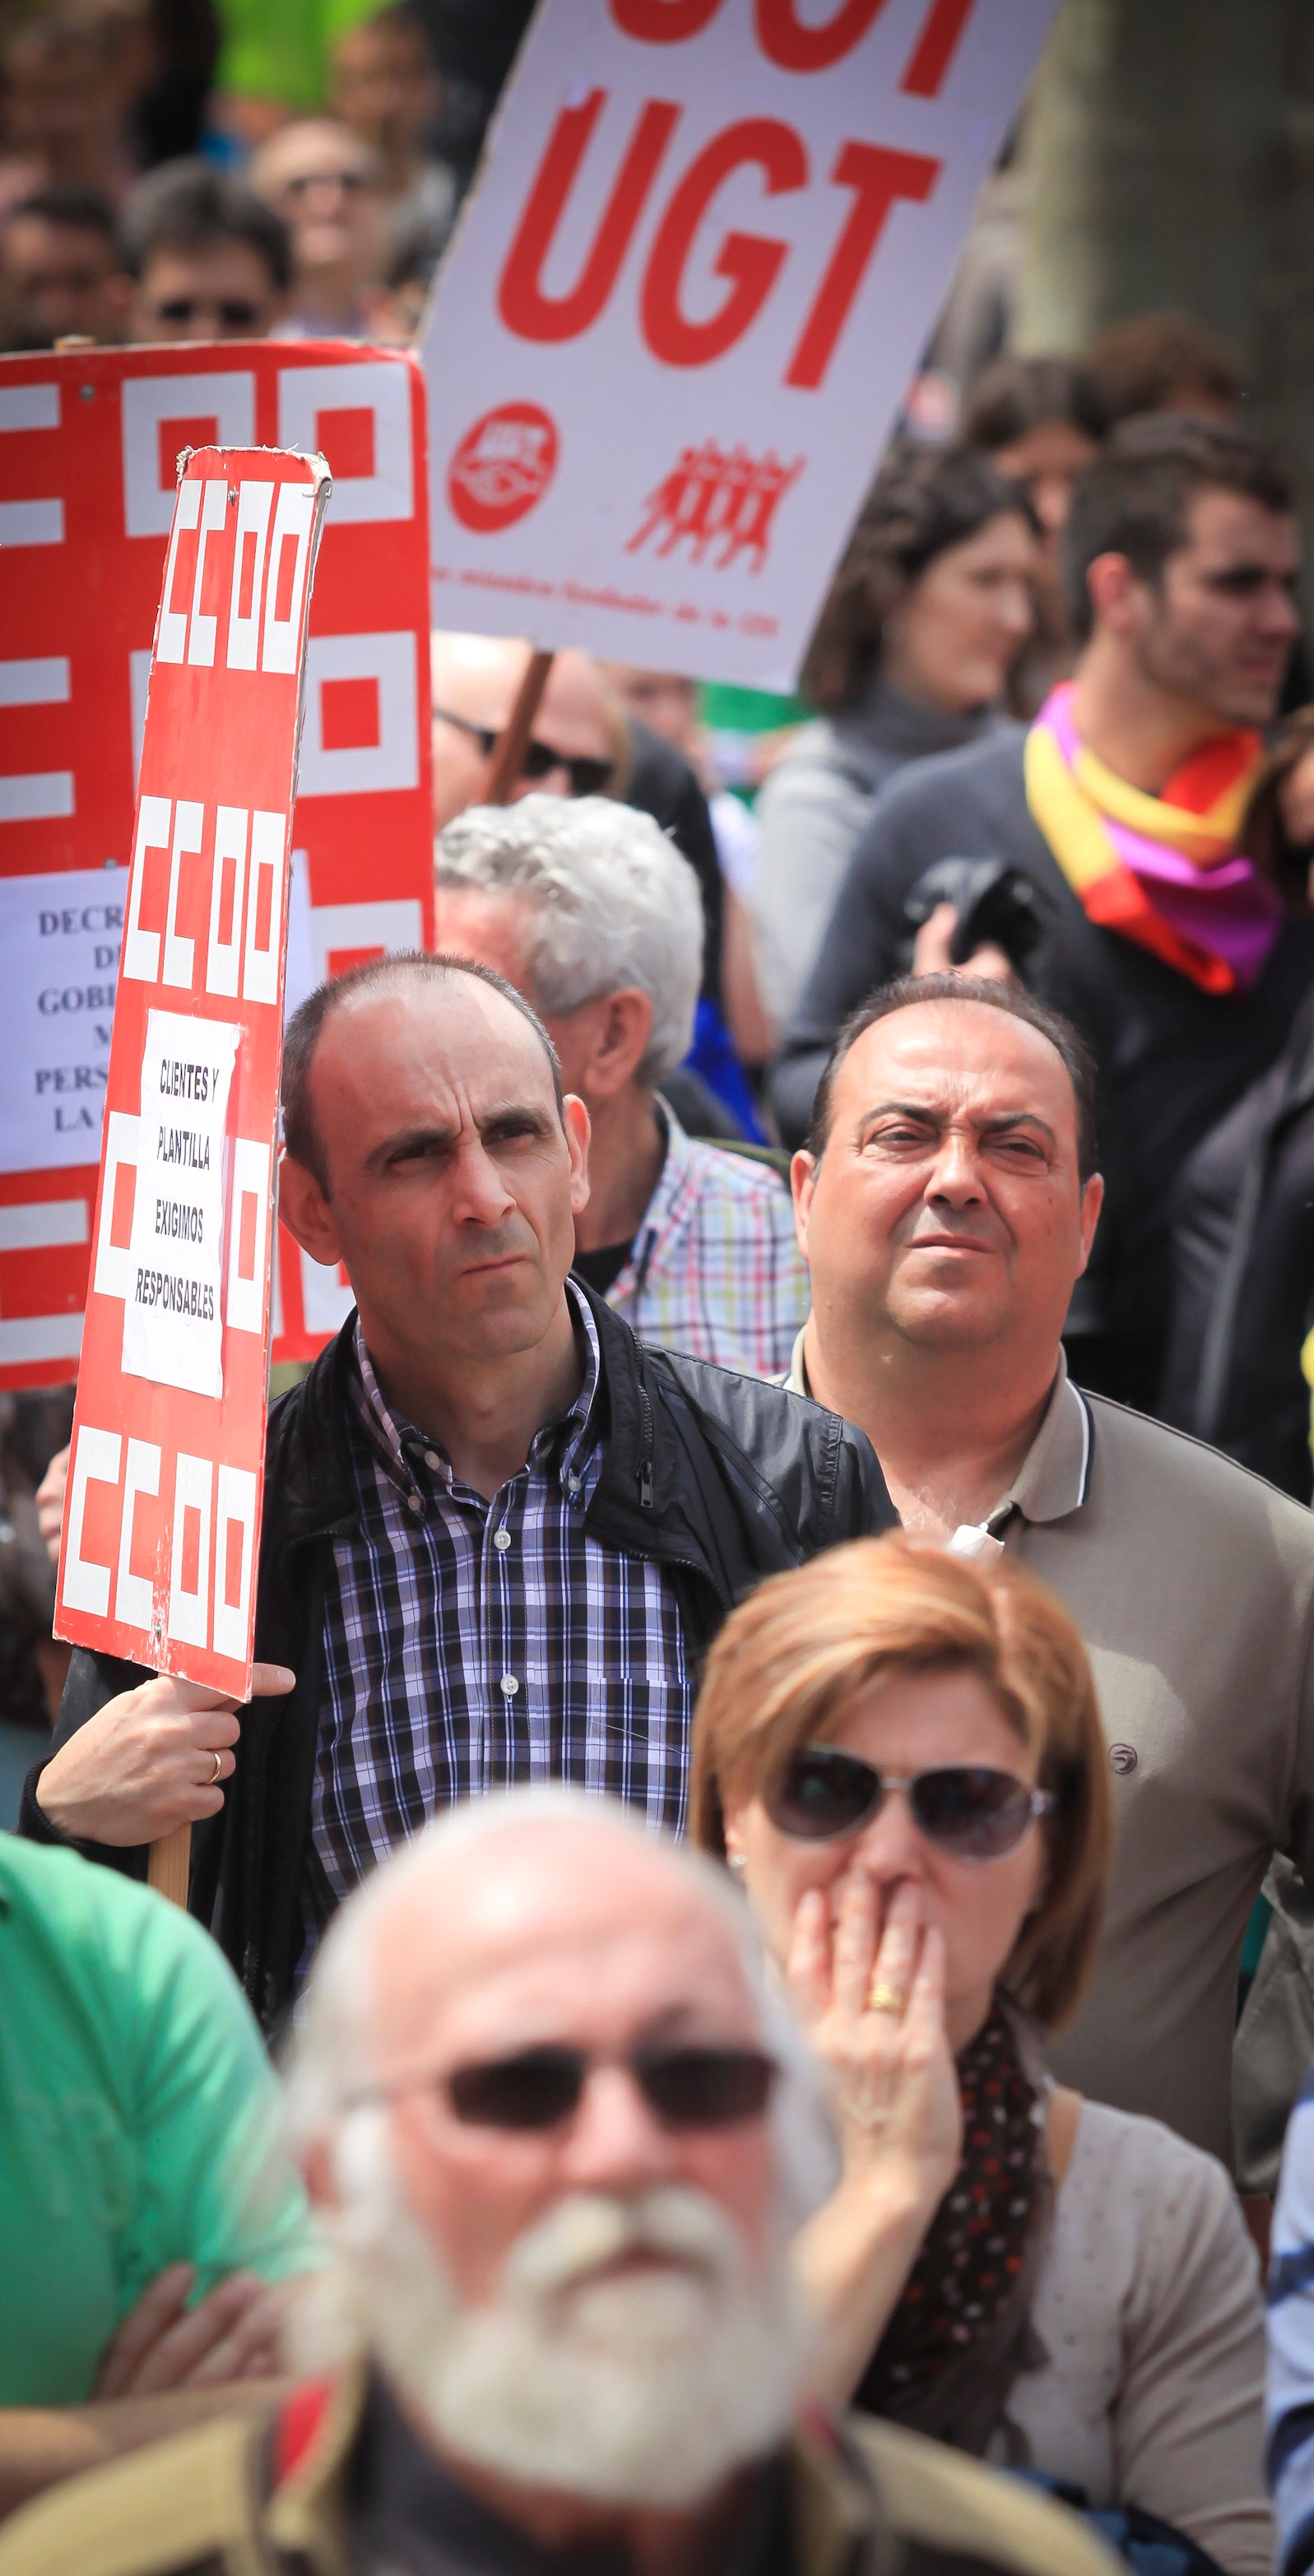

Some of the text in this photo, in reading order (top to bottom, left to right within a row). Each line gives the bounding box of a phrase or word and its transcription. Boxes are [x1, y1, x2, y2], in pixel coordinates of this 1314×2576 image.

[497, 86, 945, 393] UGT
[156, 480, 316, 675] CCOO
[39, 903, 124, 936] DECR
[123, 795, 286, 1005] CCOO
[35, 1063, 110, 1096] PERS
[160, 1058, 220, 1103] CLIENTES Y
[156, 1125, 211, 1171] PLANTILLA
[155, 1199, 204, 1245] EXIGIMOS
[134, 1268, 215, 1322] RESPONSABLES
[62, 1424, 257, 1663] CCOO
